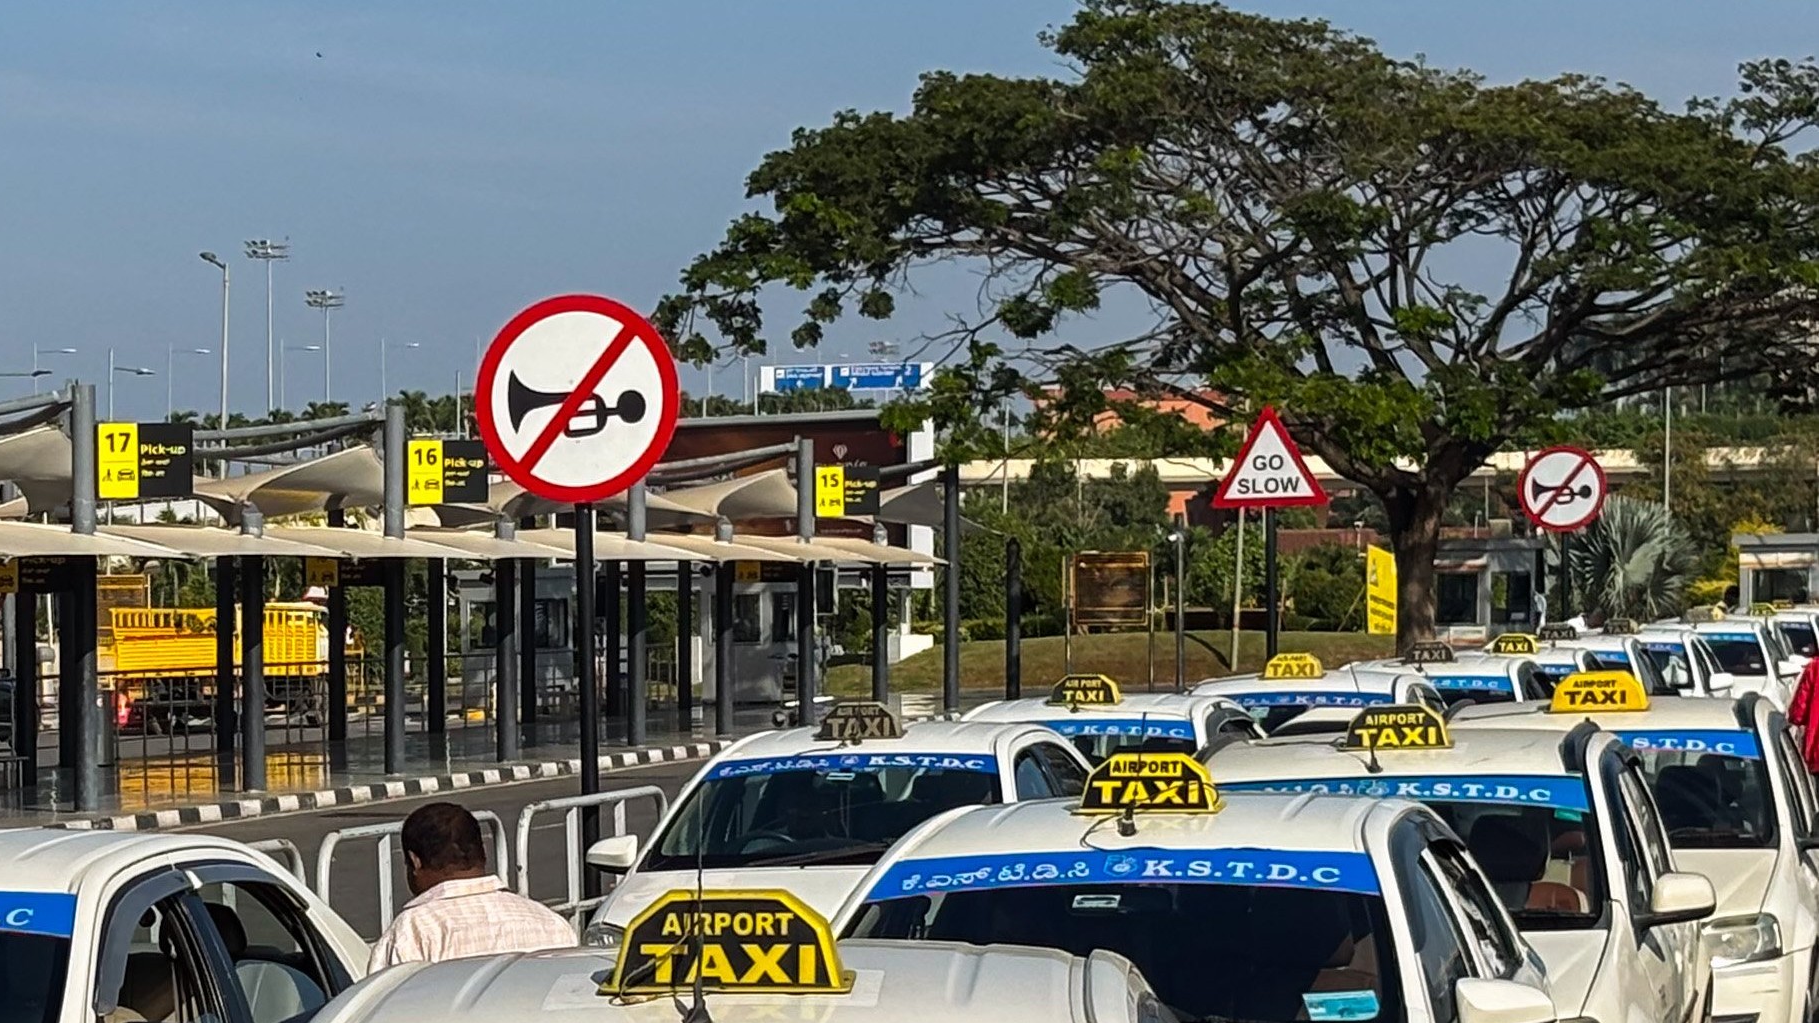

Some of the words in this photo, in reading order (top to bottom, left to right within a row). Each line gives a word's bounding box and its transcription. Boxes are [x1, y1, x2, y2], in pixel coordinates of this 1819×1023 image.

[105, 432, 131, 452] 17
[140, 443, 186, 455] Pick-up
[414, 448, 437, 465] 16
[1252, 454, 1284, 471] GO
[821, 474, 839, 488] 15
[1237, 476, 1301, 495] SLOW
[1413, 650, 1446, 661] TAXI
[1499, 642, 1529, 652] TAXI
[1269, 663, 1315, 676] TAXI
[1573, 679, 1617, 688] AIRPORT
[1062, 690, 1105, 702] TAXI
[1564, 689, 1627, 705] TAXI
[1365, 711, 1426, 726] AIRPORT
[826, 717, 890, 738] TAXI
[1354, 727, 1438, 747] TAXI
[1632, 736, 1735, 754] S.T.D.C
[868, 755, 985, 769] K.S.T.D.C
[1111, 759, 1182, 775] AIRPORT
[1092, 780, 1200, 806] TAXI
[1396, 783, 1552, 802] K.S.T.D.C
[1141, 860, 1340, 884] K.S.T.D.C
[661, 912, 795, 936] AIRPORT
[640, 943, 817, 985] TAXI
